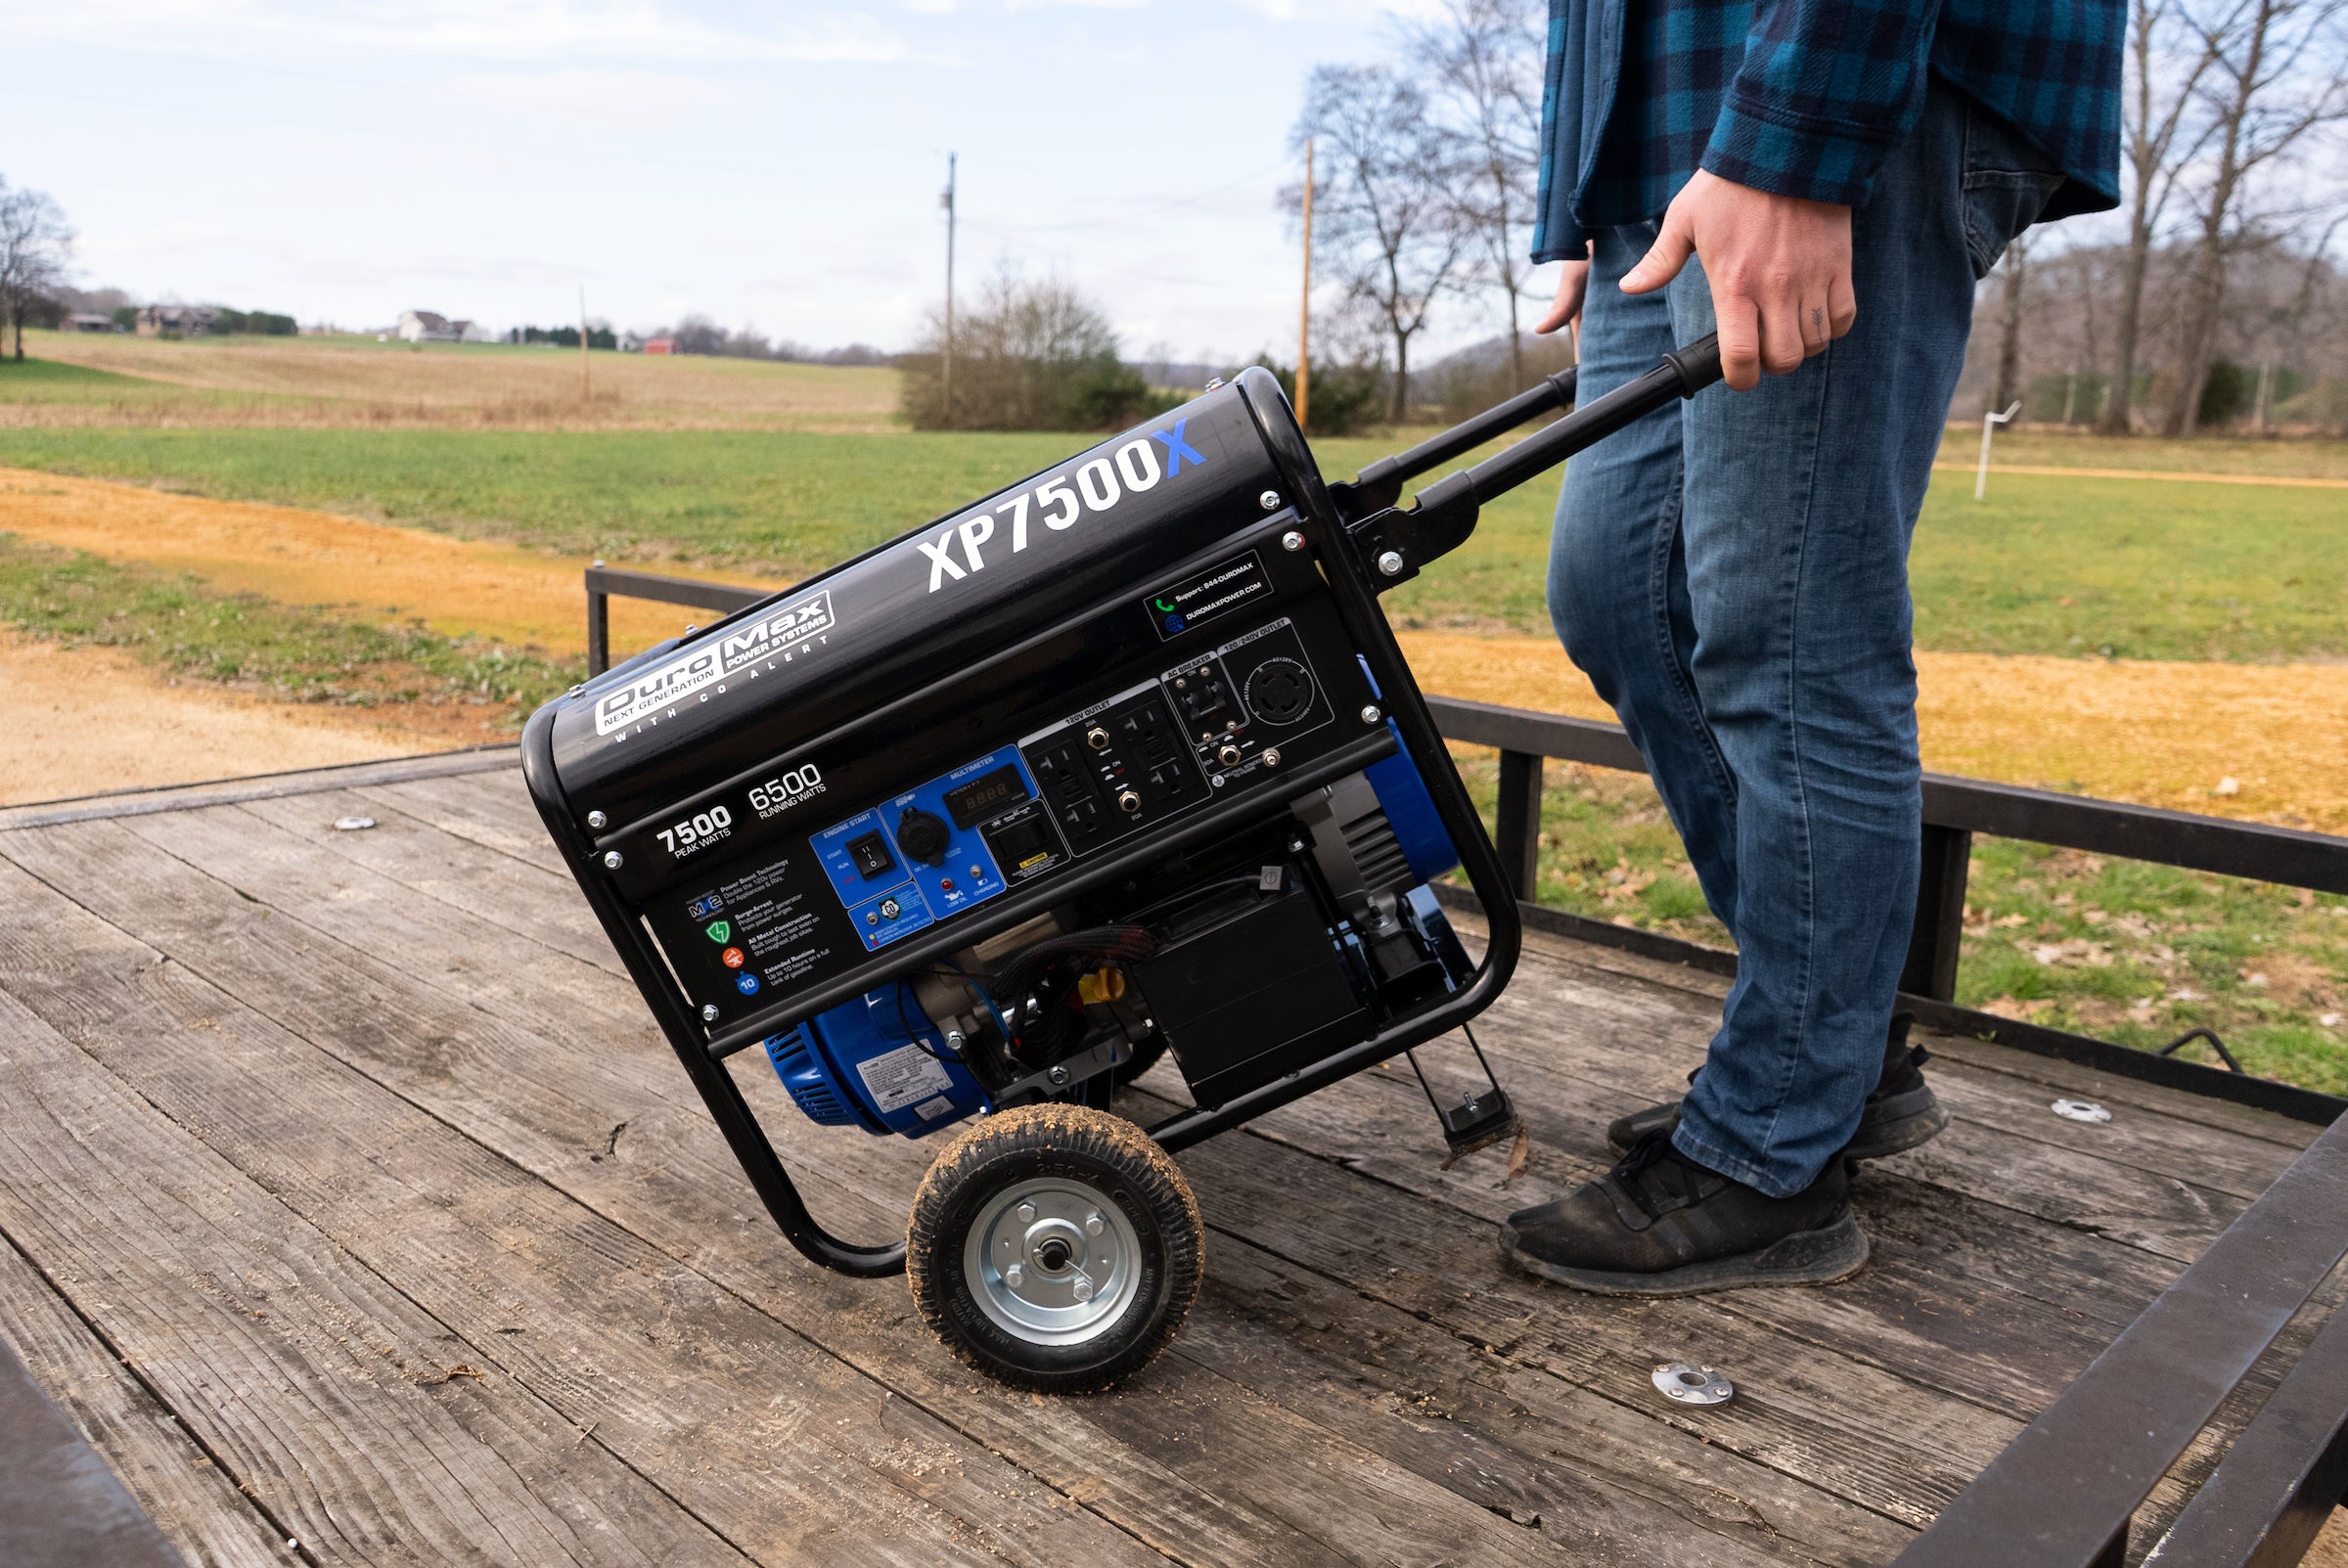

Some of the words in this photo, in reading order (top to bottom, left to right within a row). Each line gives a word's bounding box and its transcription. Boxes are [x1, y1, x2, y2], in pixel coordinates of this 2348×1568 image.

[917, 418, 1206, 594] XP7500X
[1175, 587, 1203, 602] Support:
[1203, 562, 1253, 590] 844-DUROMAX
[1186, 582, 1262, 620] DUROMAXPOWER.COM
[1259, 619, 1285, 635] OUTLET
[726, 645, 769, 669] POWER
[771, 614, 827, 648] SYSTEMS
[1178, 654, 1210, 672] BREAKER
[604, 706, 634, 727] NEXT
[638, 669, 714, 710] GENERATION
[615, 708, 677, 743] WITH
[700, 685, 727, 703] CO
[750, 636, 828, 679] ALERT
[1065, 713, 1083, 724] 120V
[1084, 700, 1110, 716] OUTLET
[950, 755, 993, 780] MULTIMETER
[748, 763, 822, 811] 6500
[758, 799, 798, 820] RUNNING
[796, 784, 827, 801] WATTS
[656, 806, 732, 852] 7500
[823, 822, 849, 838] ENGINE
[849, 812, 871, 828] START
[674, 840, 700, 859] PEAK
[700, 828, 731, 848] WATTS
[720, 880, 739, 892] Power
[739, 873, 755, 883] Boost
[757, 859, 789, 875] Technology
[973, 881, 998, 896] CHARGING
[736, 884, 765, 901] Appliances
[738, 912, 762, 925] Protects
[763, 907, 776, 916] your
[776, 894, 802, 909] generator
[742, 922, 754, 931] from
[756, 915, 773, 926] power
[756, 929, 773, 940] Metal
[775, 912, 811, 932] Construction
[751, 941, 764, 950] Built
[765, 934, 781, 945] tough
[765, 938, 789, 953] roughest
[764, 959, 790, 973] Extended
[790, 948, 814, 962] Runtime
[792, 959, 807, 968] hours
[741, 978, 755, 990] 10
[770, 977, 784, 987] tank
